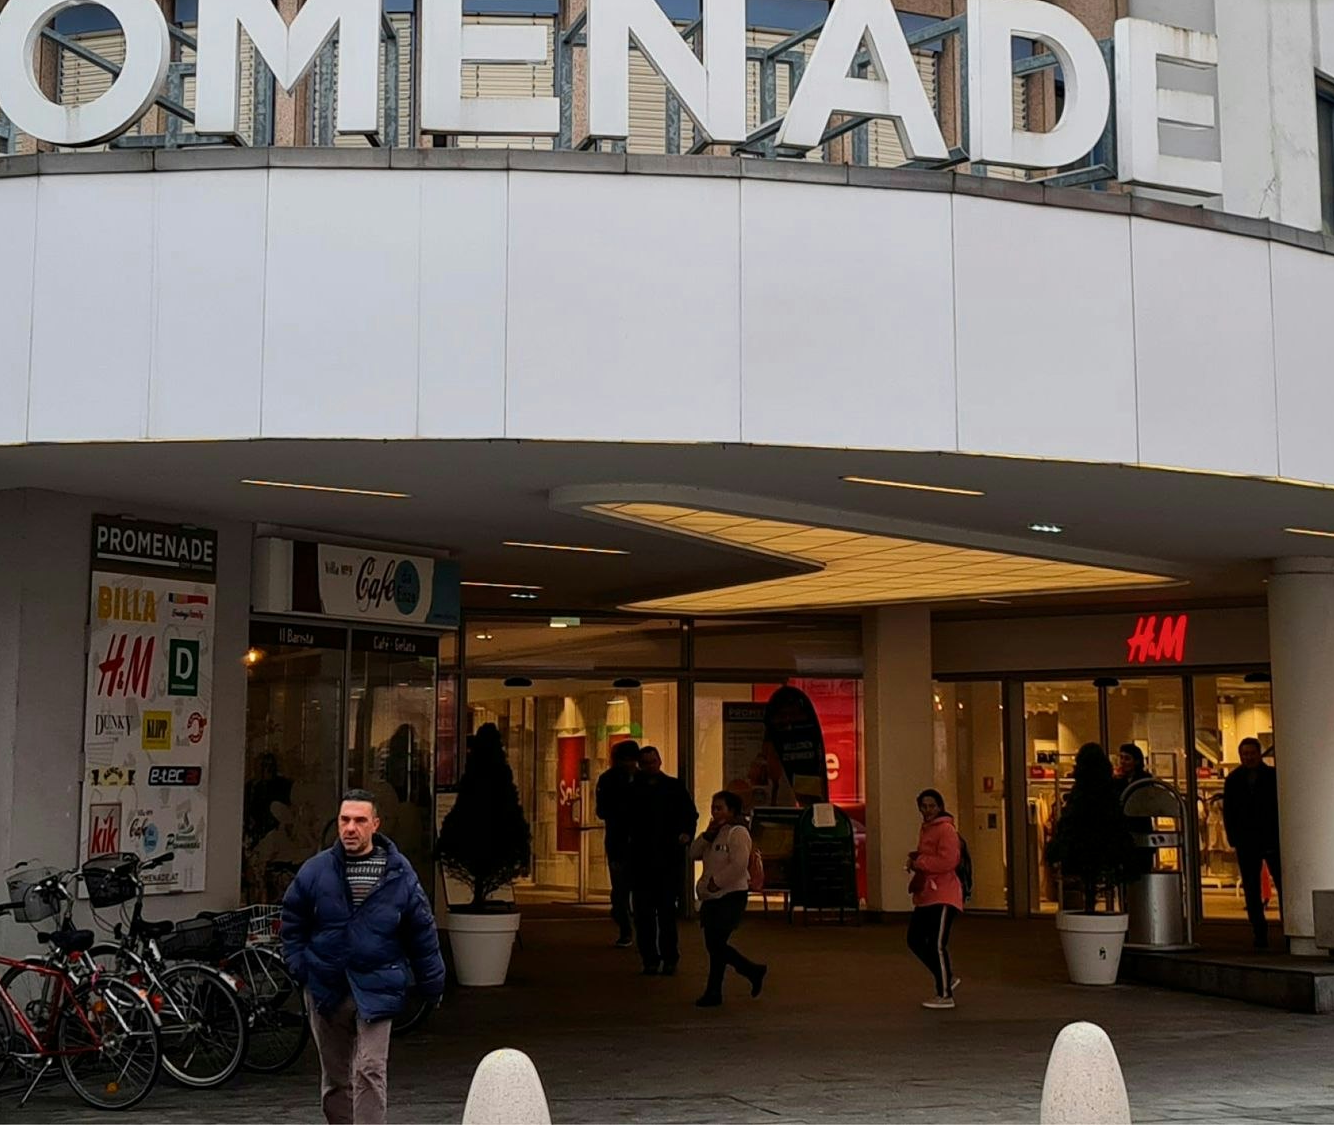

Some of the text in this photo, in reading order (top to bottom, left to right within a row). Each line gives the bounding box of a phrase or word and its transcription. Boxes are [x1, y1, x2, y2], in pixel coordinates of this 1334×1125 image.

[97, 525, 214, 563] PROMENADE
[97, 585, 157, 623] BILLA
[356, 556, 397, 612] Cafe
[1126, 613, 1189, 664] H&M
[98, 633, 156, 700] H&M
[95, 714, 133, 736] DUNKY
[91, 808, 118, 854] kik
